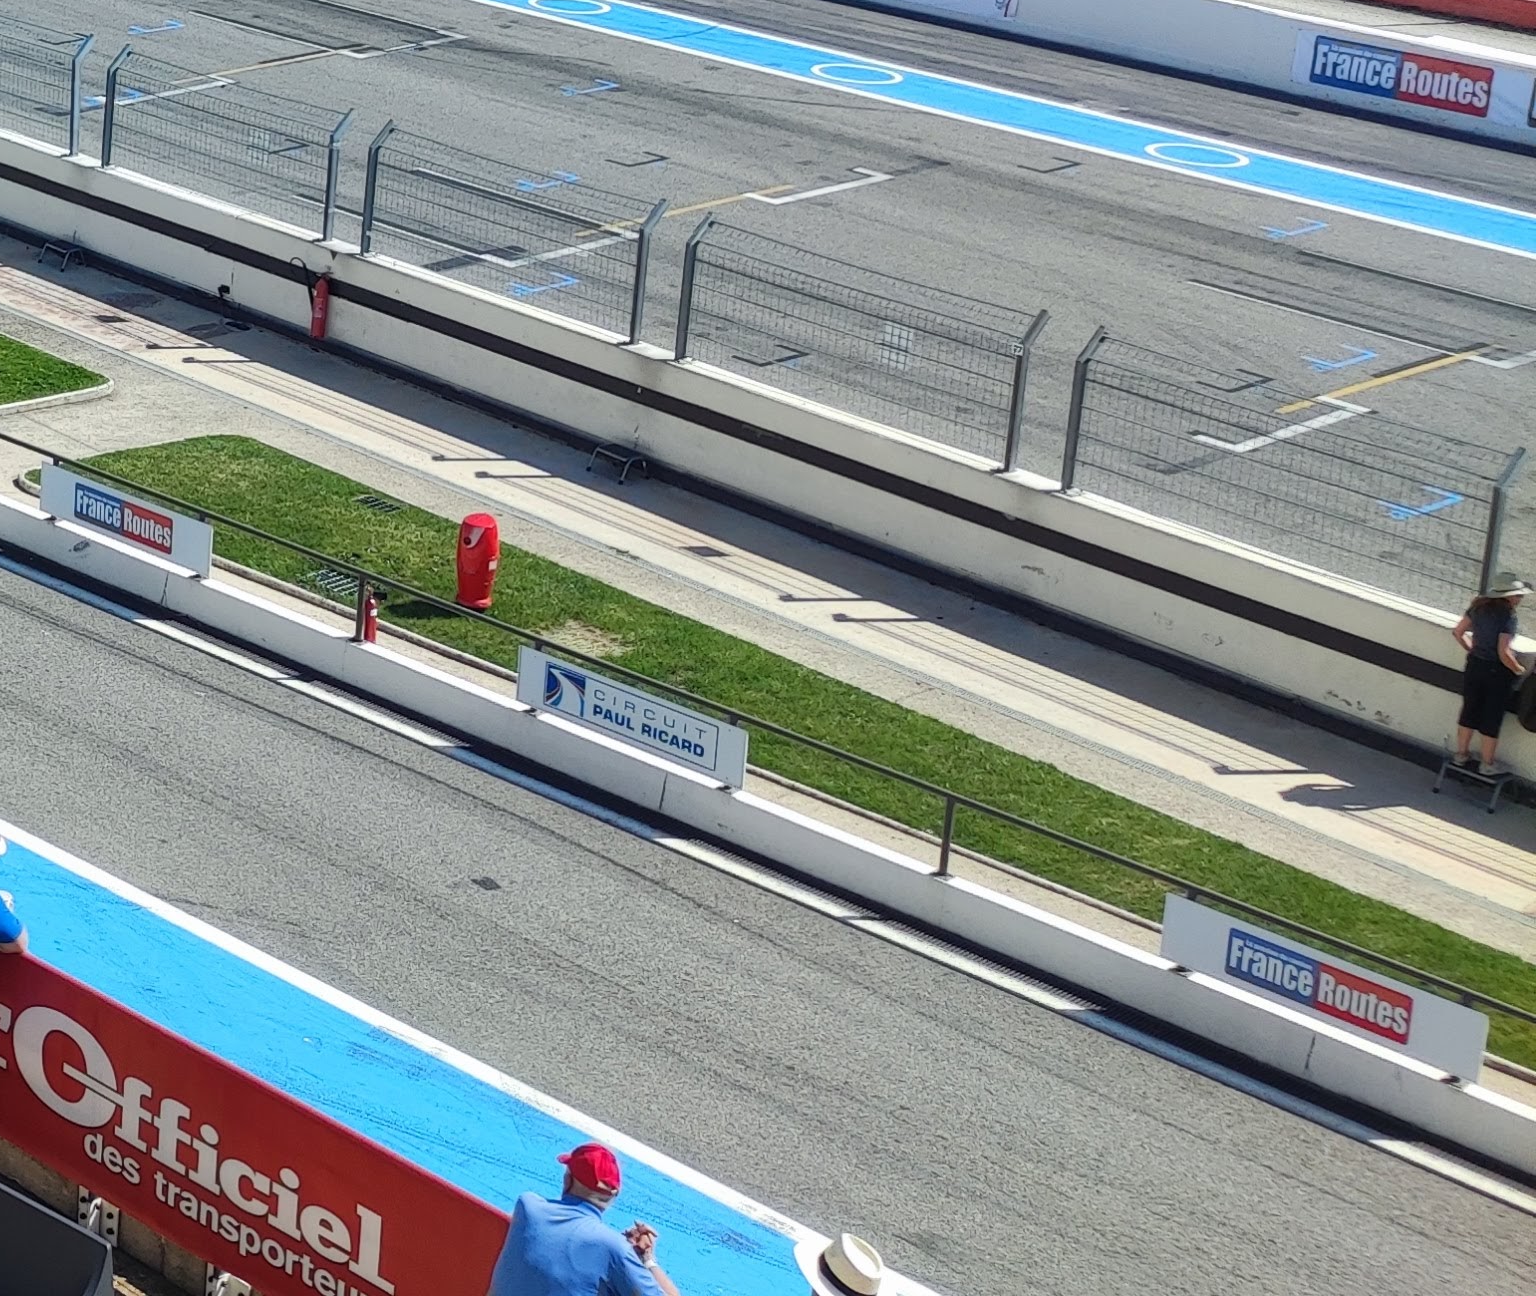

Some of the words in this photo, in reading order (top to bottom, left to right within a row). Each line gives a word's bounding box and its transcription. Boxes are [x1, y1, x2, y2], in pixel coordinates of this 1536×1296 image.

[1313, 44, 1397, 90] France
[1399, 61, 1489, 109] Routes
[77, 489, 122, 528] France
[123, 508, 172, 548] Routes
[593, 689, 707, 741] CIRCUIT
[593, 704, 635, 731] PAUL
[641, 723, 705, 758] RICARD
[1229, 936, 1314, 998] France
[1317, 971, 1410, 1036] Routes
[83, 1132, 141, 1185] des
[153, 1170, 368, 1296] transporteu
